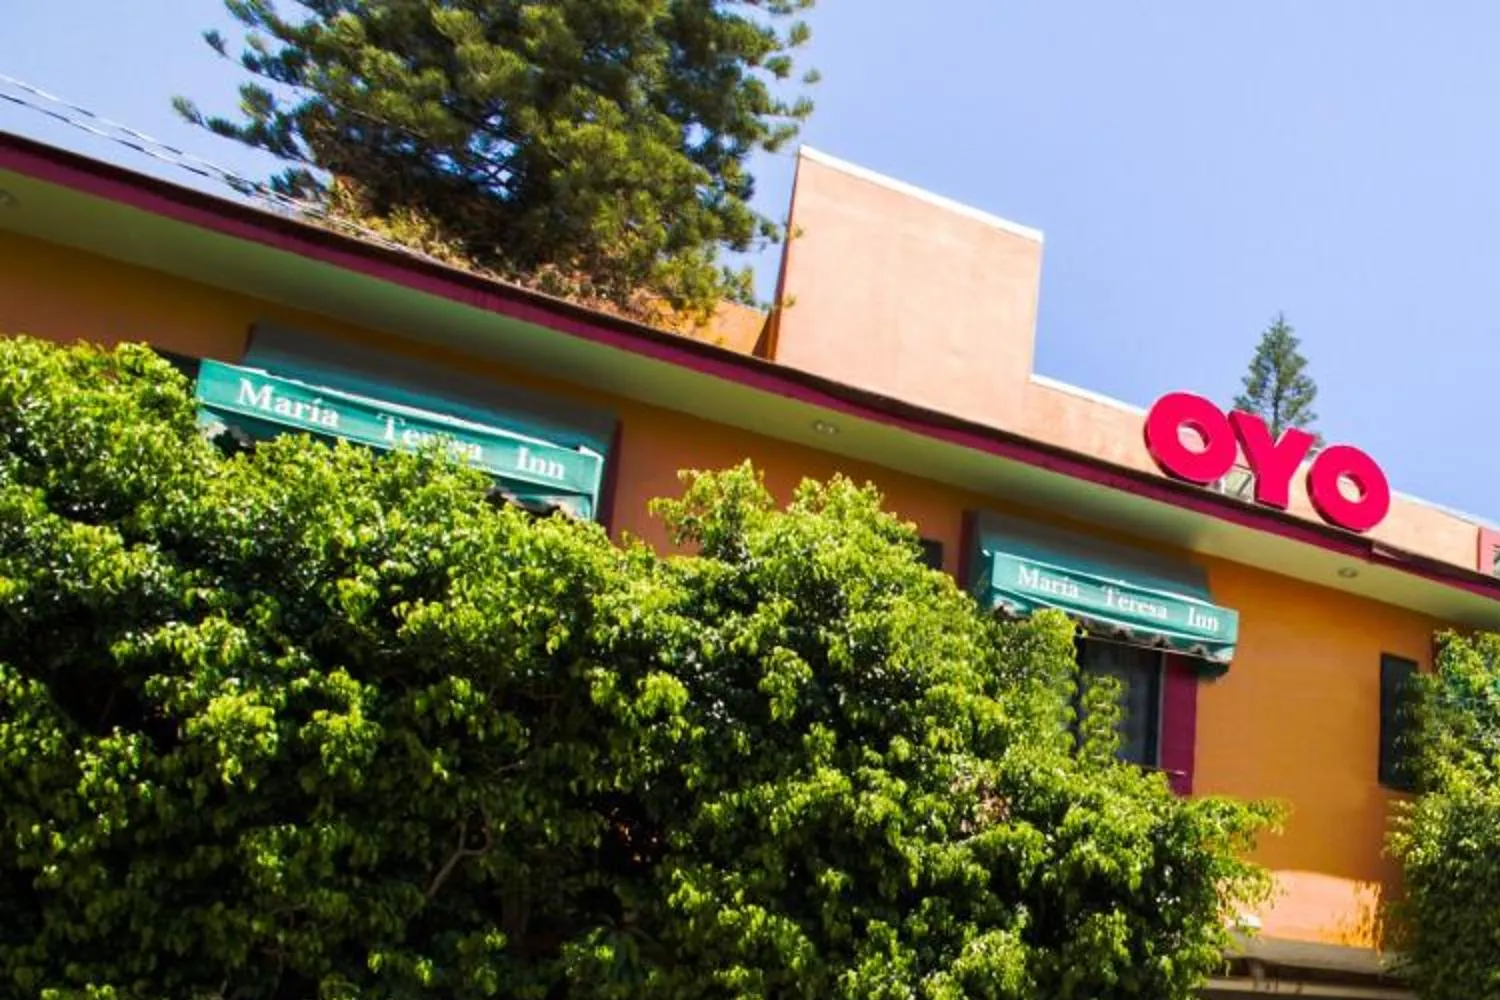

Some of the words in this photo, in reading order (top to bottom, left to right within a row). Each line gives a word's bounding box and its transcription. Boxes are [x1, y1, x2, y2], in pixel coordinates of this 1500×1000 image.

[236, 377, 340, 427] María
[515, 446, 566, 480] Inn
[1143, 391, 1391, 533] OYO
[1103, 585, 1169, 620] Teresa
[1188, 606, 1219, 632] Inn
